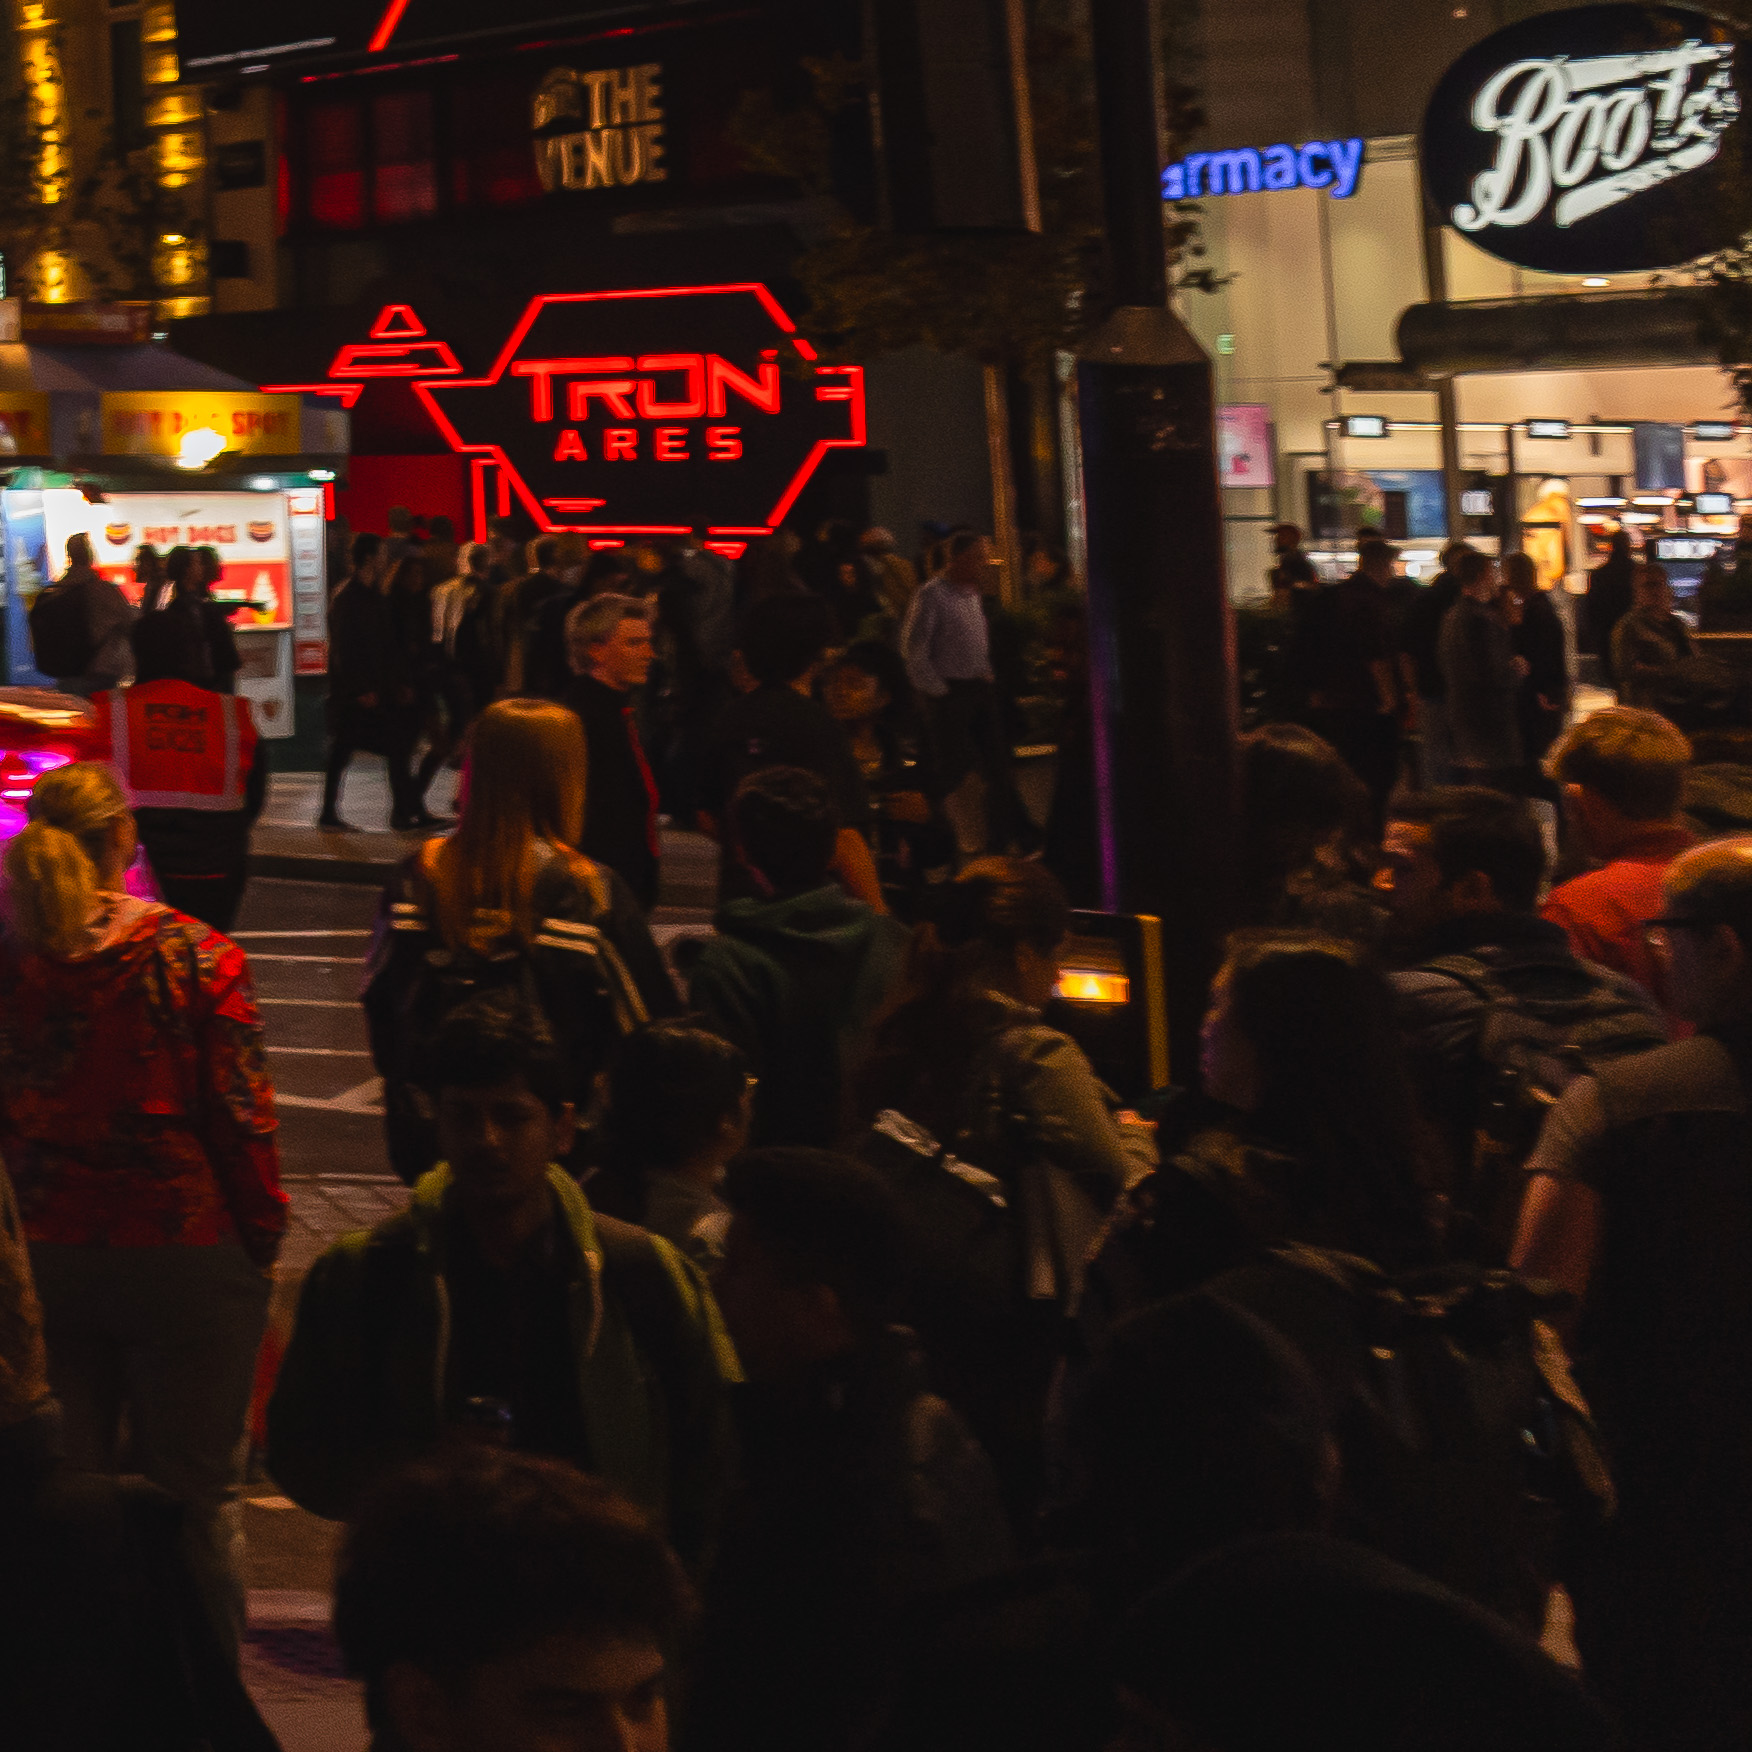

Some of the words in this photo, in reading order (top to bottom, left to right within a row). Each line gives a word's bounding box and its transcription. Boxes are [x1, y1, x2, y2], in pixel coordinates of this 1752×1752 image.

[582, 63, 665, 130] THE
[533, 124, 669, 193] VENUE
[1450, 38, 1743, 232] Boots
[510, 349, 783, 423] TRON
[552, 426, 744, 462] ARES
